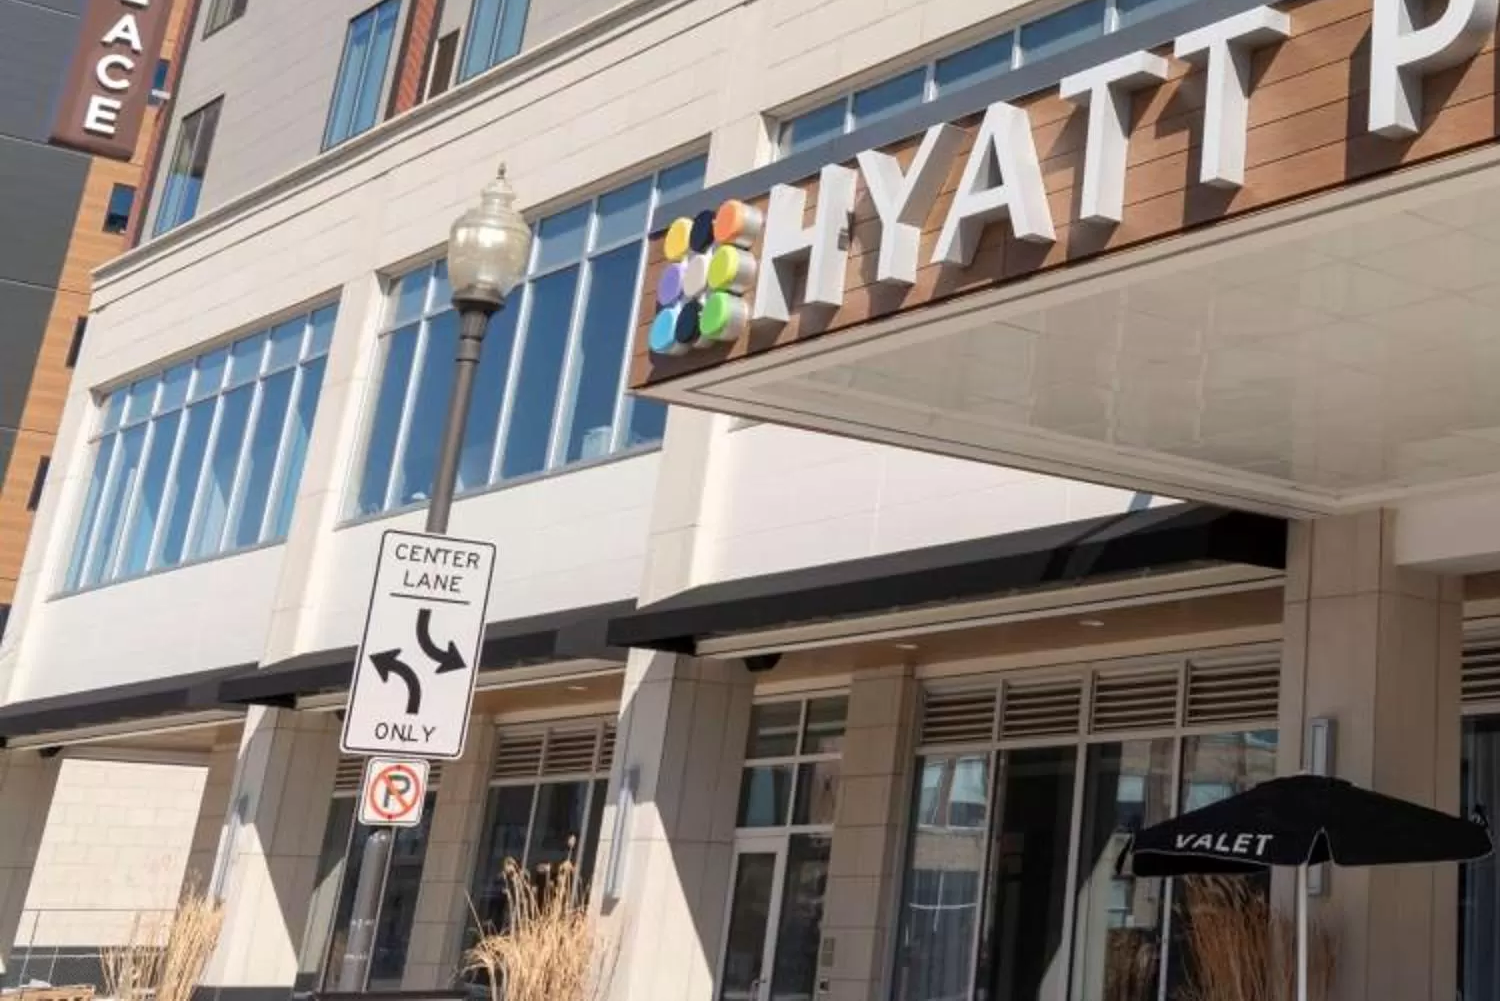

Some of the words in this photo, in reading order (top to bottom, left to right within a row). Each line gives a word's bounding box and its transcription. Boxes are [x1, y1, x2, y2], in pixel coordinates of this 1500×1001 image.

[752, 5, 1291, 323] HYATT
[394, 544, 480, 570] CENTER
[403, 571, 463, 593] LANE
[374, 722, 437, 744] ONLY
[1175, 833, 1273, 857] VALET
